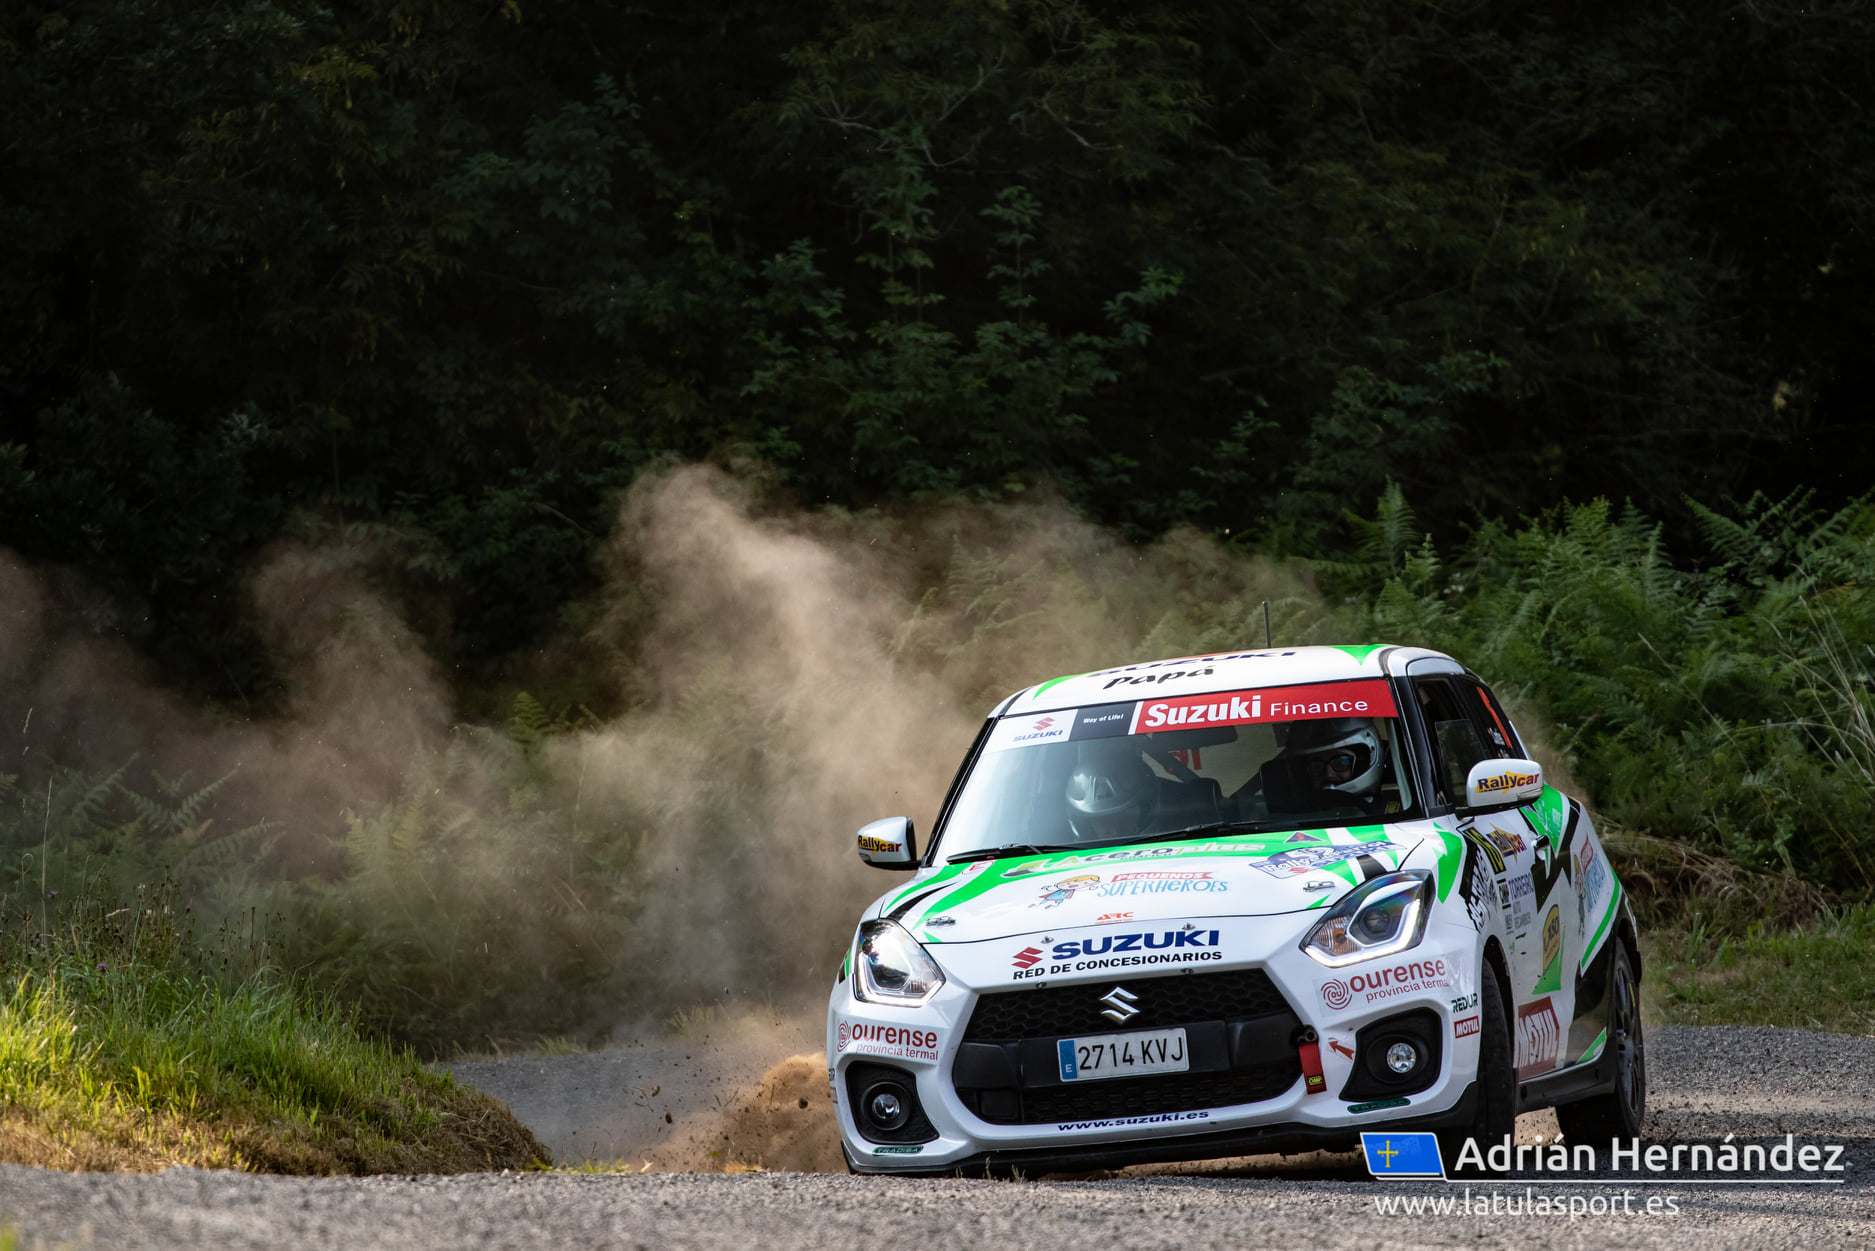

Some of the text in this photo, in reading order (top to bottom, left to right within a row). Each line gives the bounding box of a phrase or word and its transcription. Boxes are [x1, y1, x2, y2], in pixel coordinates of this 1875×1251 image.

[1145, 695, 1368, 727] Suzuki Finance
[1013, 730, 1063, 742] SUZUKI
[1477, 773, 1540, 790] Rallycar
[858, 835, 902, 852] Rallycar
[1052, 930, 1220, 960] SUZUKI
[1013, 951, 1222, 980] RED DE CONCESIONARIOS
[1350, 960, 1446, 992] ourense
[1366, 979, 1449, 1003] provincia terma
[1451, 993, 1478, 1013] REDUR
[852, 1023, 937, 1049] ourense
[1456, 1017, 1480, 1037] MOTUL
[1513, 1010, 1559, 1068] MOTUL
[856, 1042, 938, 1060] provincia termal
[1078, 1037, 1184, 1070] 2714 KVJ
[1065, 1064, 1072, 1072] E
[1058, 1111, 1209, 1131] www.suzuki.es
